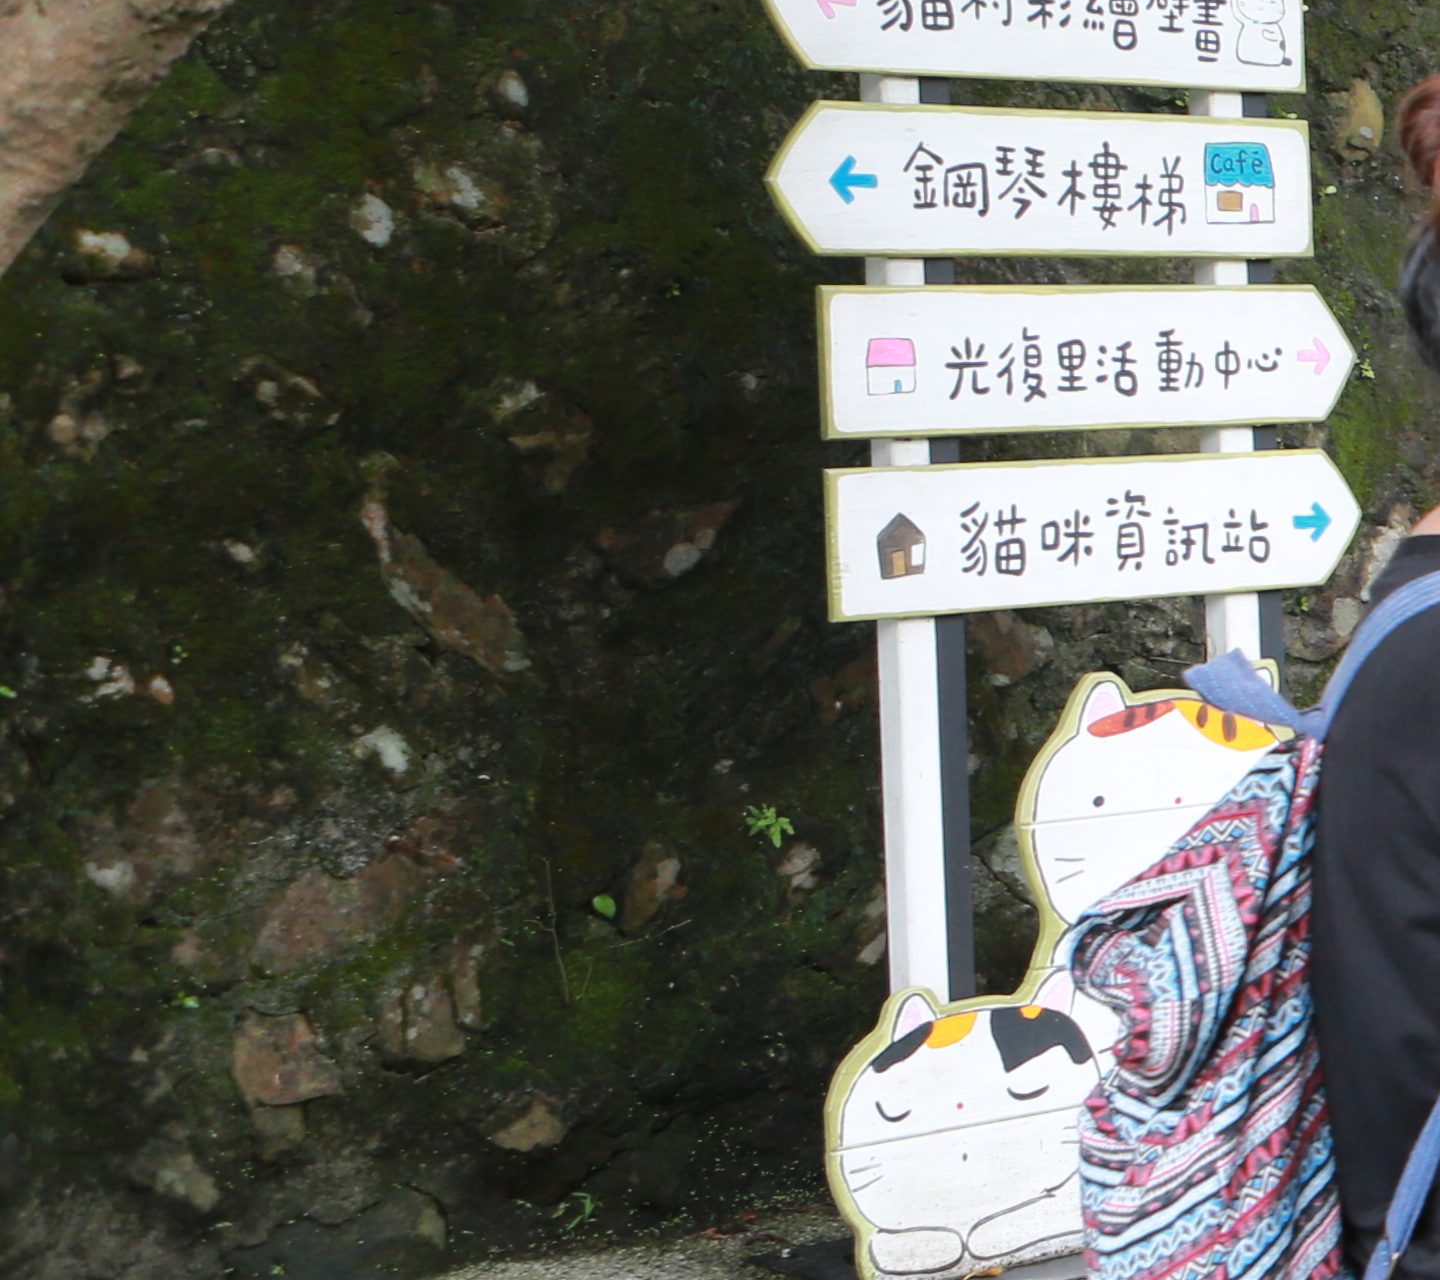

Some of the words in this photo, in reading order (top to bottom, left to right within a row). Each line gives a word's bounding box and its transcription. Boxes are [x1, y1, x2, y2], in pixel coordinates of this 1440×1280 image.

[903, 141, 1188, 237] 鋼琴樓梯
[944, 327, 1284, 402] 光復里活動中心
[959, 490, 1271, 577] 貓咪資訊站
